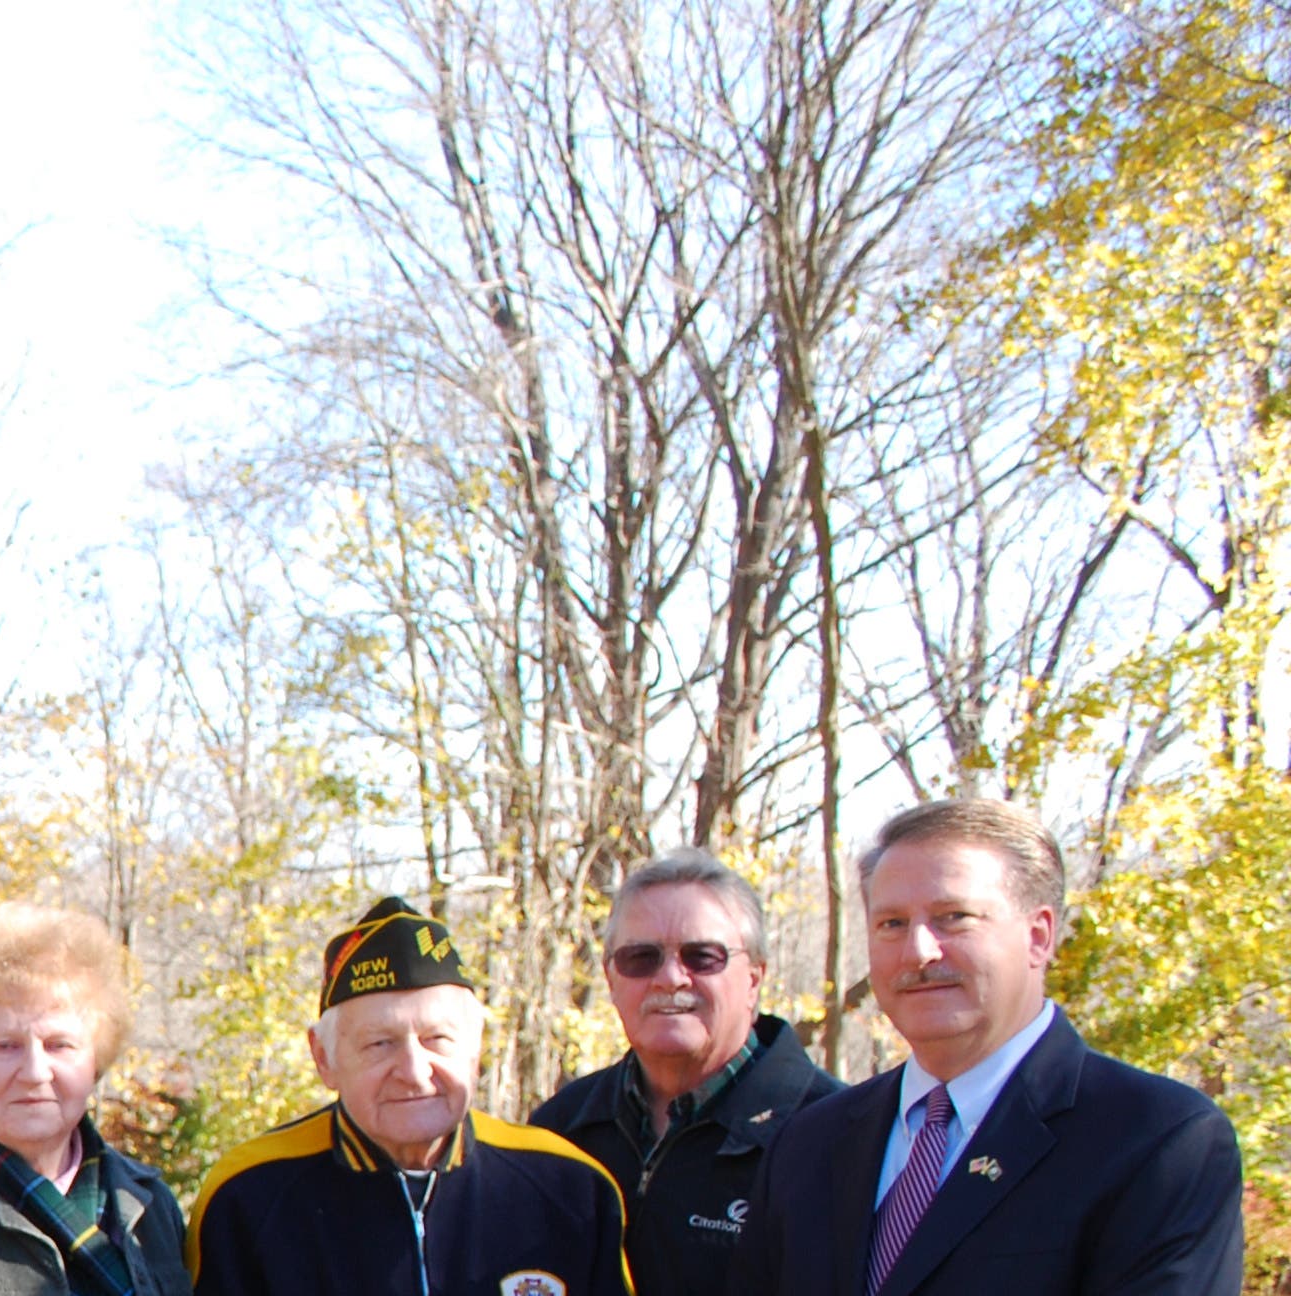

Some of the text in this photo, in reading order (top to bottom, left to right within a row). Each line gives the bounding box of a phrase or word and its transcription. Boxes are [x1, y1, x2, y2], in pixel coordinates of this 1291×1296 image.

[351, 957, 389, 975] VFW
[350, 971, 396, 992] 10201
[688, 1213, 742, 1234] Citation
